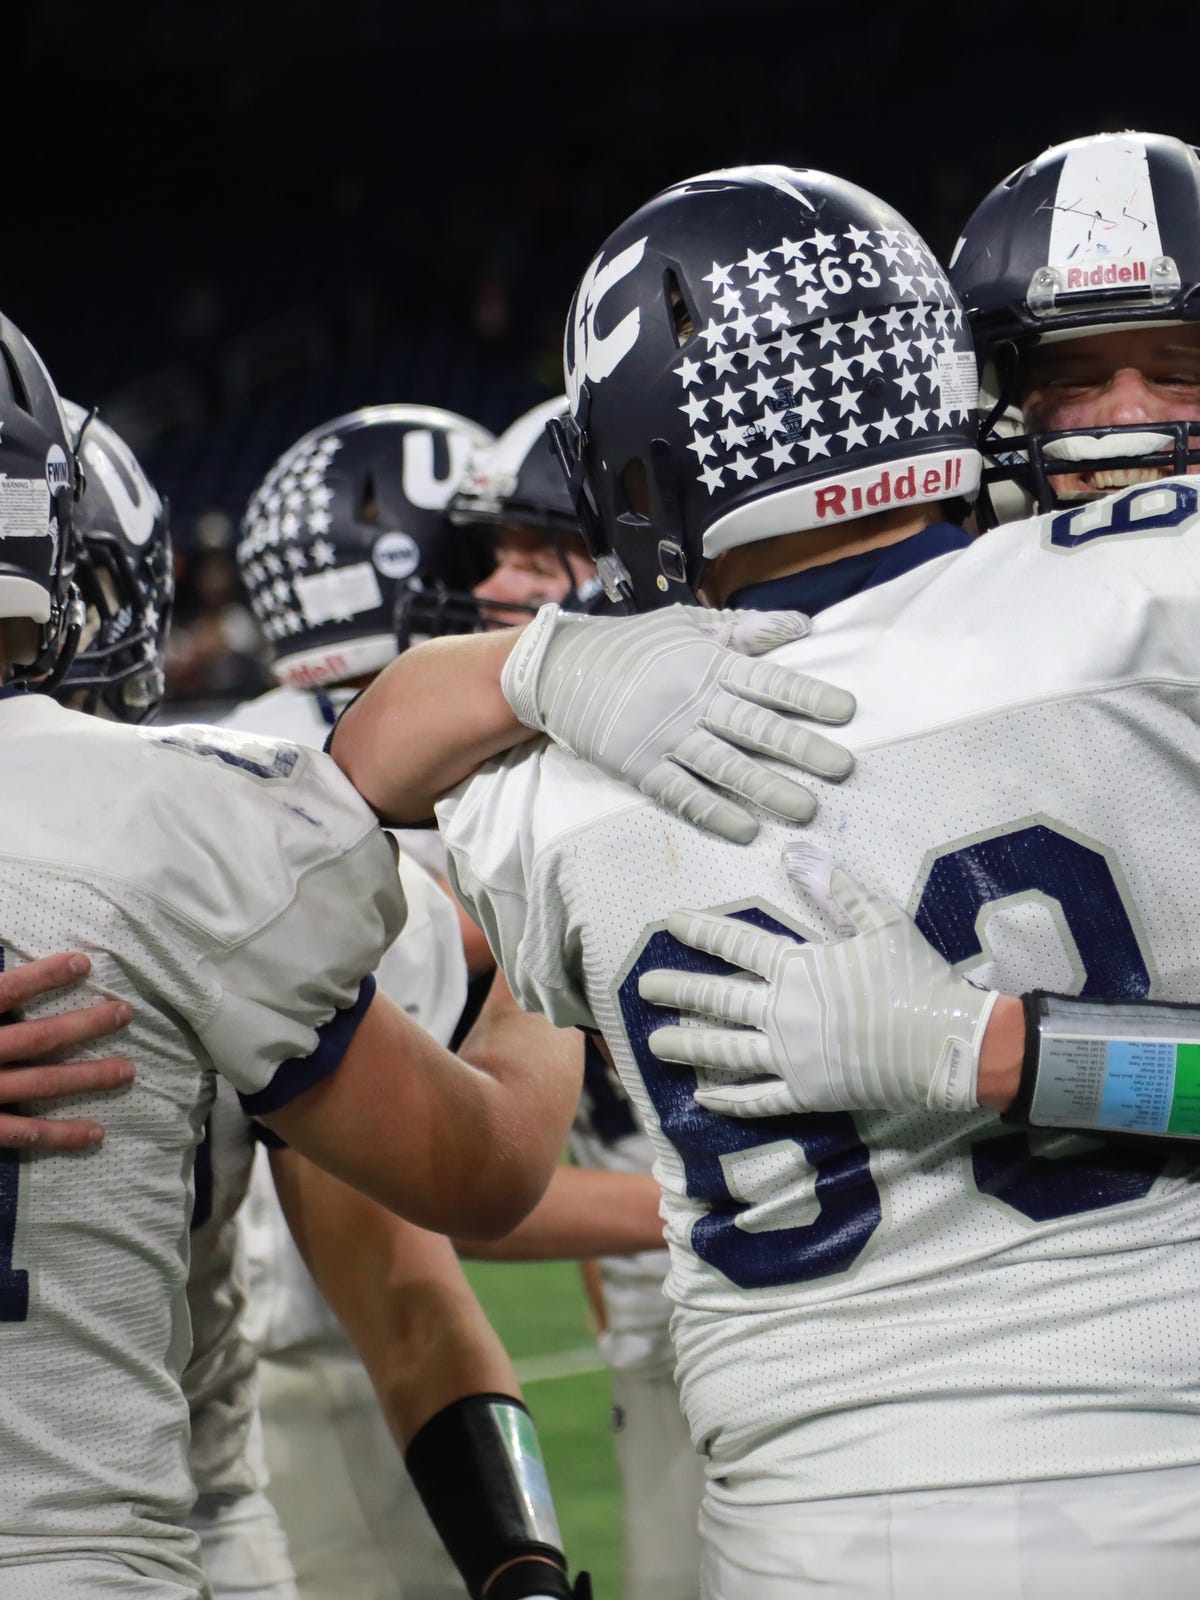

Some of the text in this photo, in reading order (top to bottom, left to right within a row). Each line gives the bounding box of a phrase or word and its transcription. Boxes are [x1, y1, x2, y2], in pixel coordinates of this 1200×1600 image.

[820, 252, 881, 294] 63
[1067, 261, 1146, 289] Riddell
[815, 457, 962, 519] Riddell
[615, 820, 1158, 1295] 63
